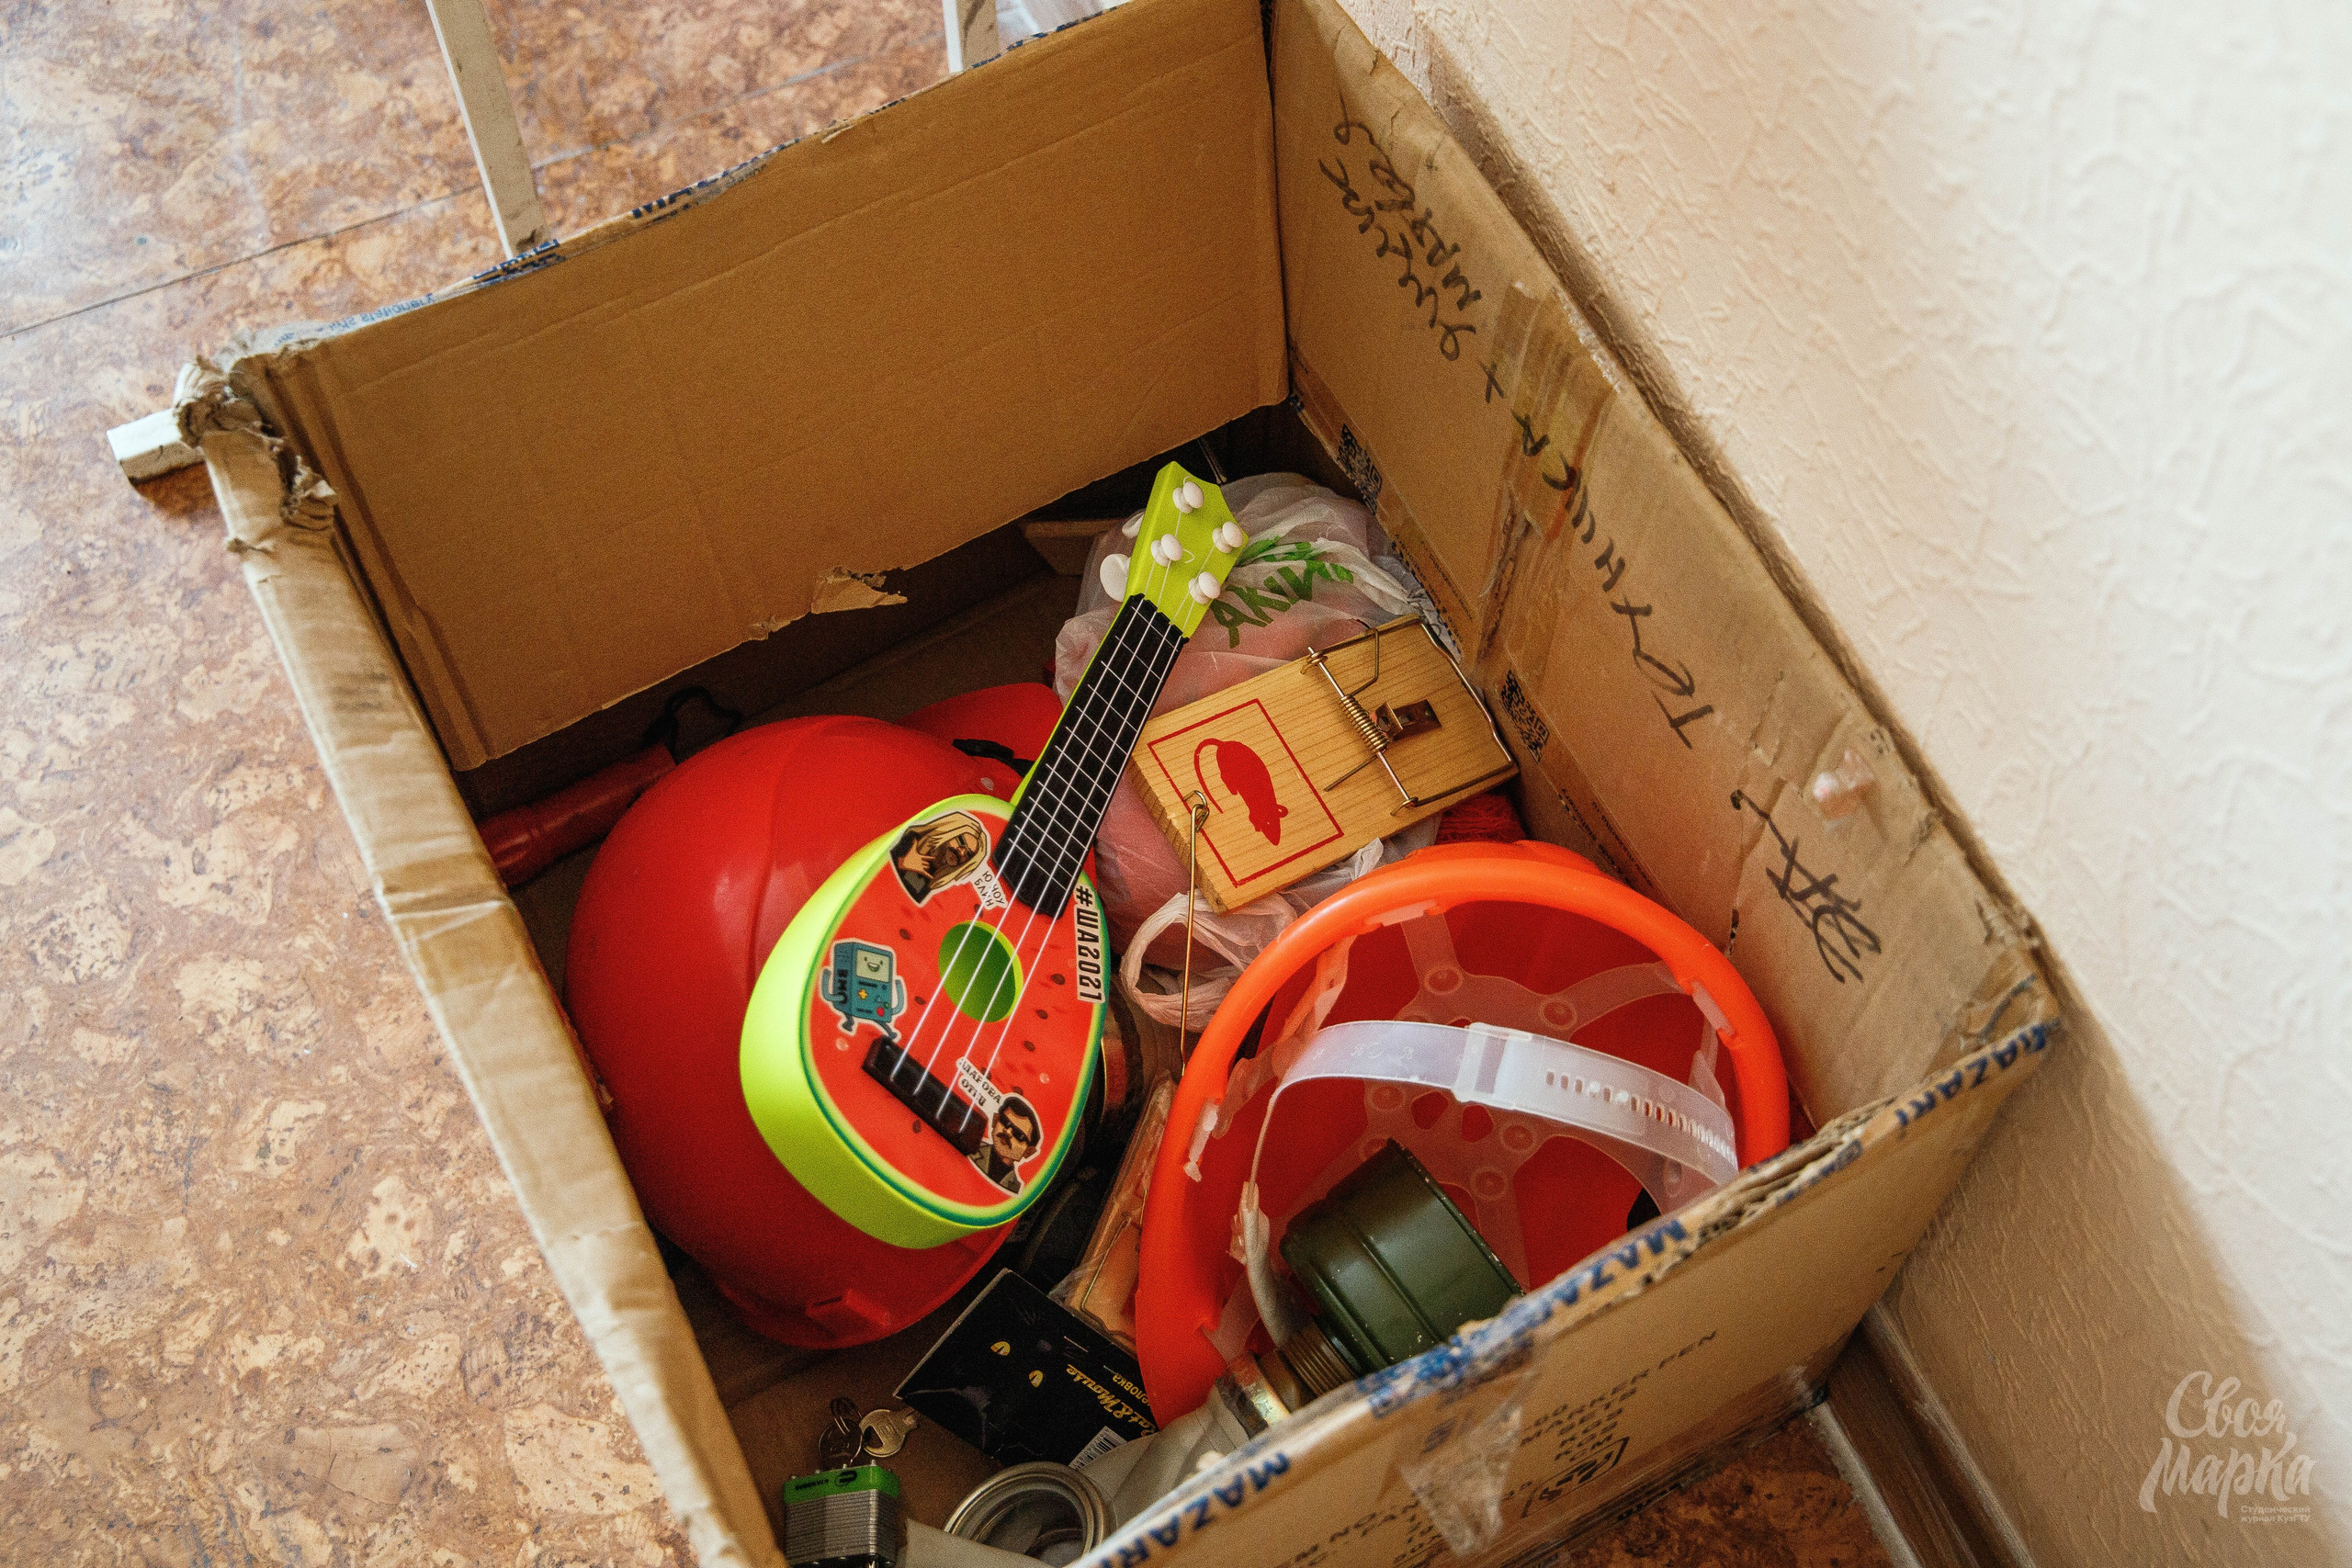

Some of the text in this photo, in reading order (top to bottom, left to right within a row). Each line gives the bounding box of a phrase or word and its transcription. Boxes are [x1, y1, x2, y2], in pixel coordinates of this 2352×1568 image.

[981, 870, 993, 883] Ю
[1069, 885, 1104, 1002] #ША2021
[1110, 1371, 1154, 1406] еловка
